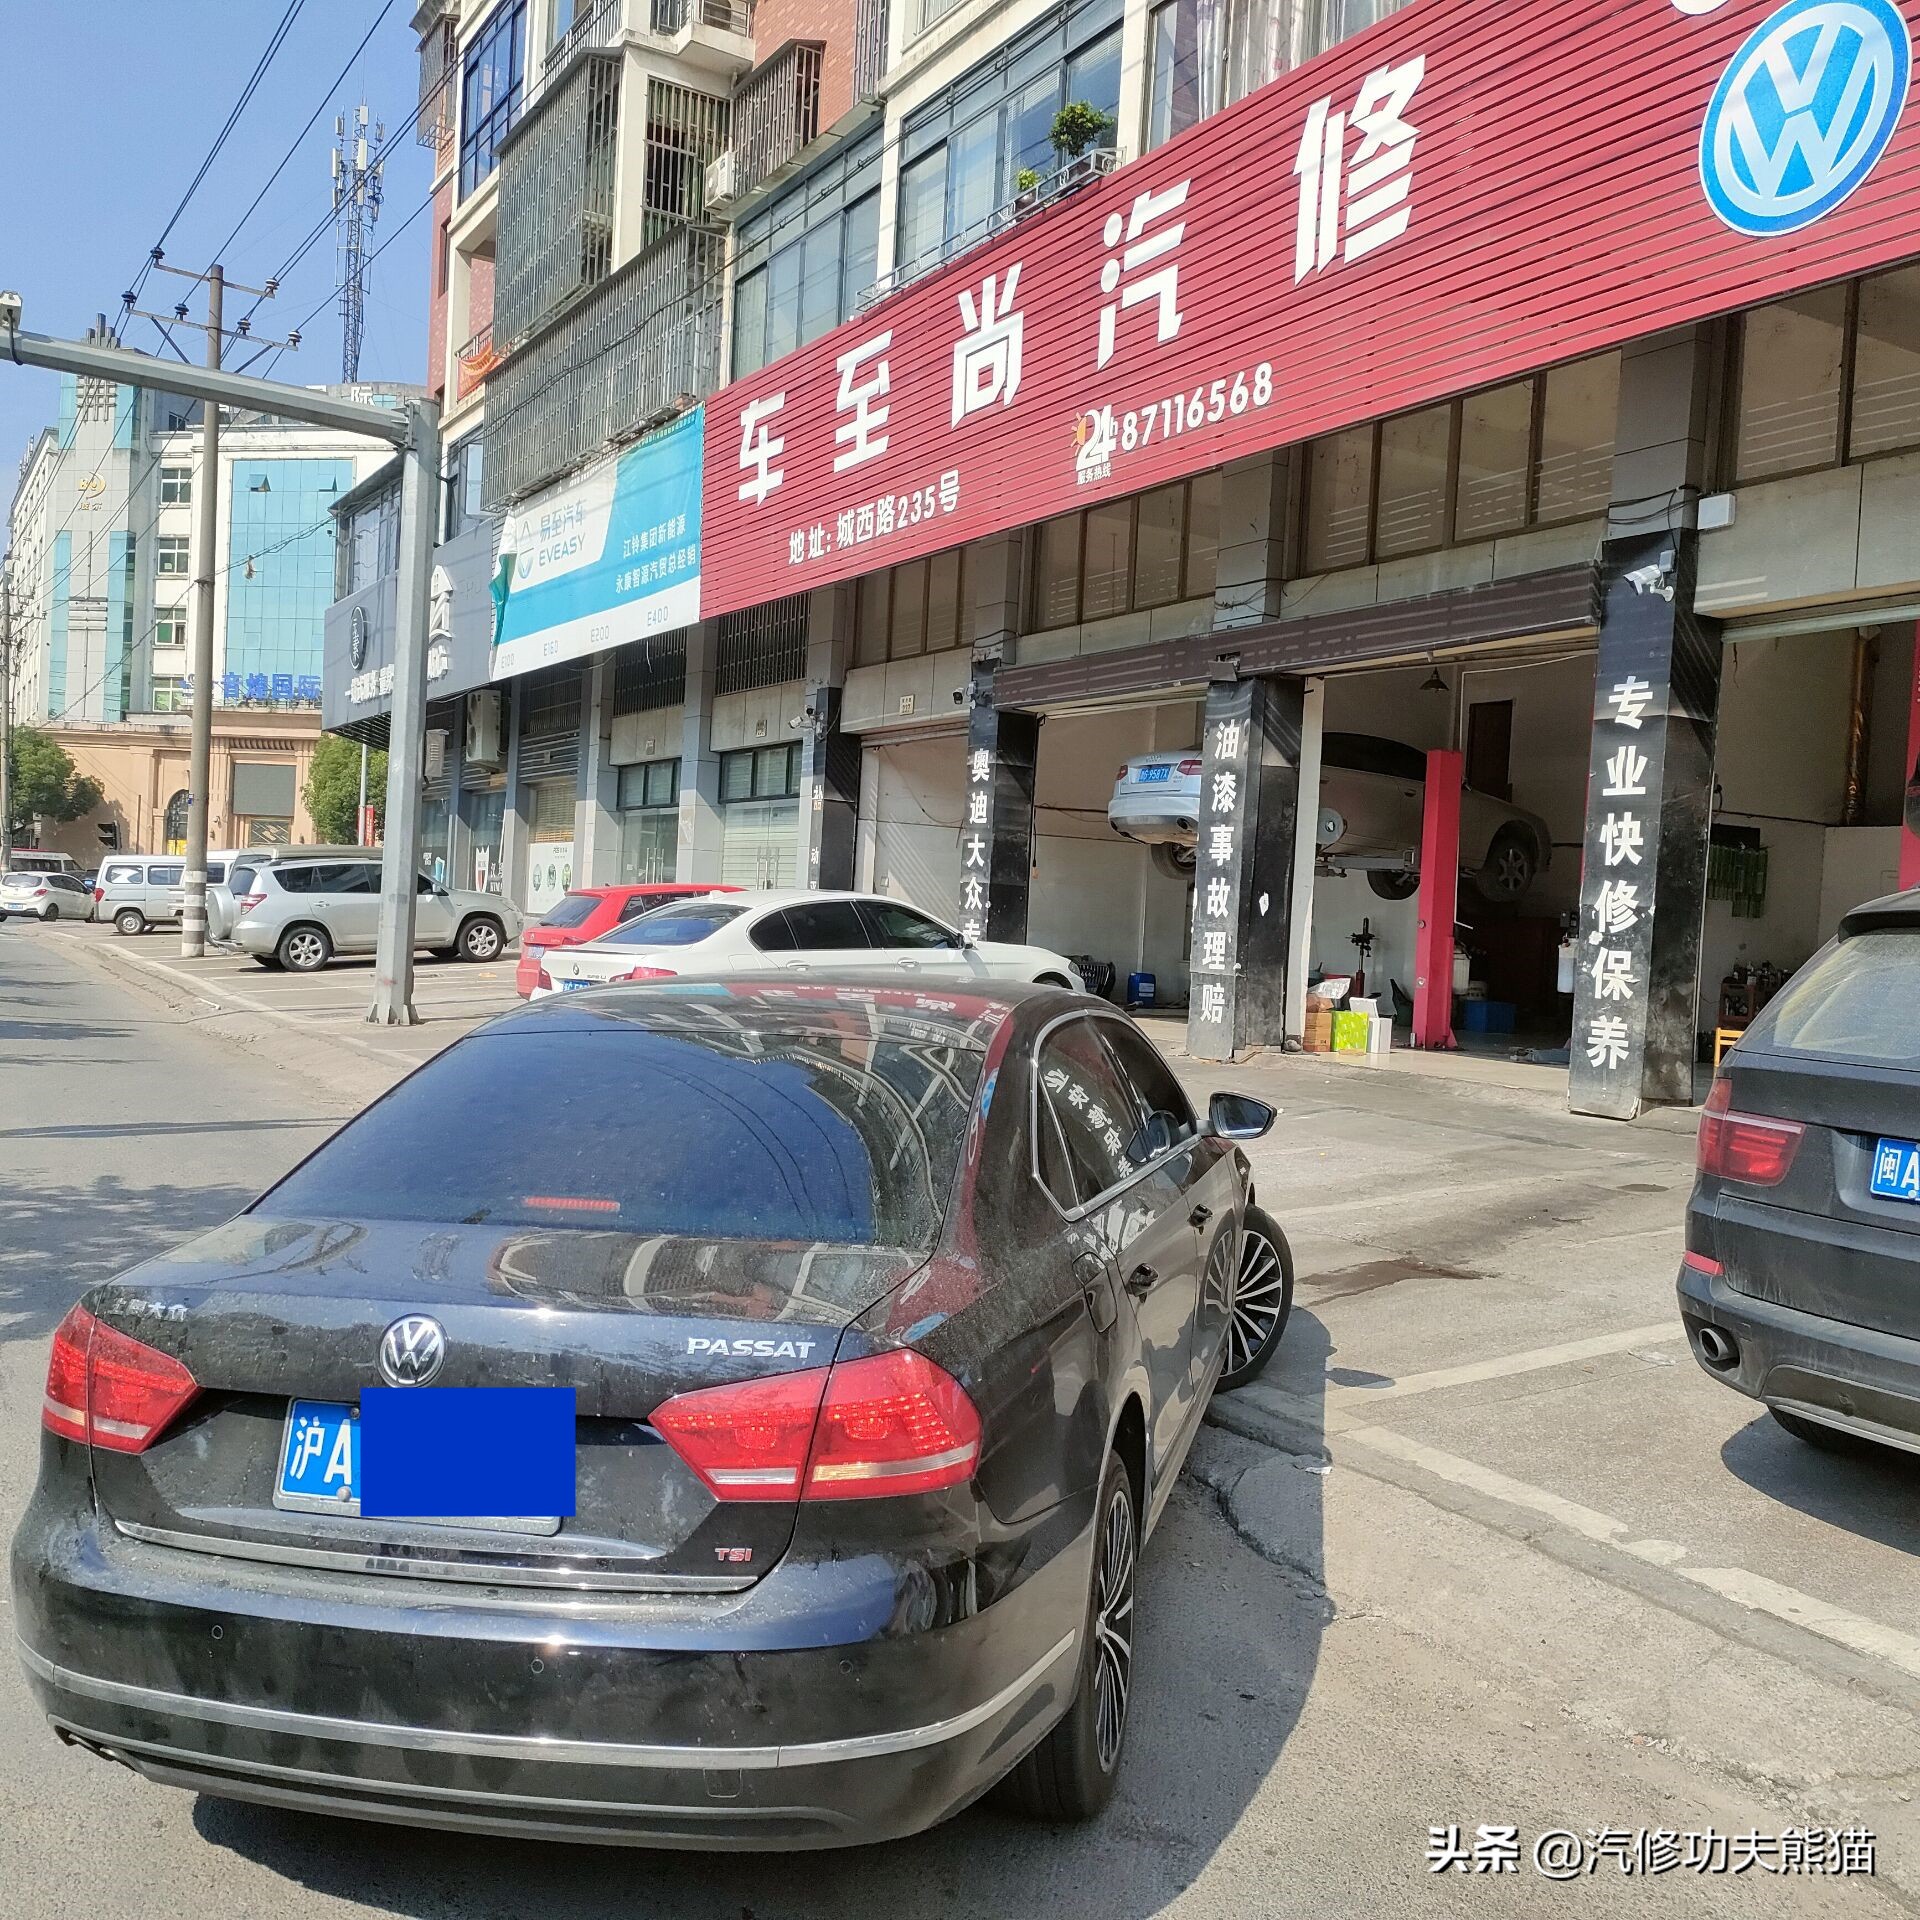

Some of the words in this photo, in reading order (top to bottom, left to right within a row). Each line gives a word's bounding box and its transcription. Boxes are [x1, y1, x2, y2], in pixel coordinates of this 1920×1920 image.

[738, 54, 1426, 506] 车至尚汽修
[1121, 362, 1274, 452] 87116568
[1077, 462, 1111, 485] 服务热线
[540, 499, 585, 543] 易至汽车
[623, 513, 687, 559] 江铃集团新能源
[539, 532, 586, 567] EVEASY
[615, 543, 697, 594] 永康智源汽贸总经销
[590, 625, 610, 643] E200
[647, 606, 669, 627] E400
[1199, 720, 1241, 1025] 油漆事故理赔
[1586, 675, 1654, 1071] 专业快修保养
[1877, 1147, 1919, 1190] 闽A
[686, 1337, 816, 1359] PASSAT
[290, 1416, 352, 1485] 沪A
[714, 1547, 753, 1562] TSI
